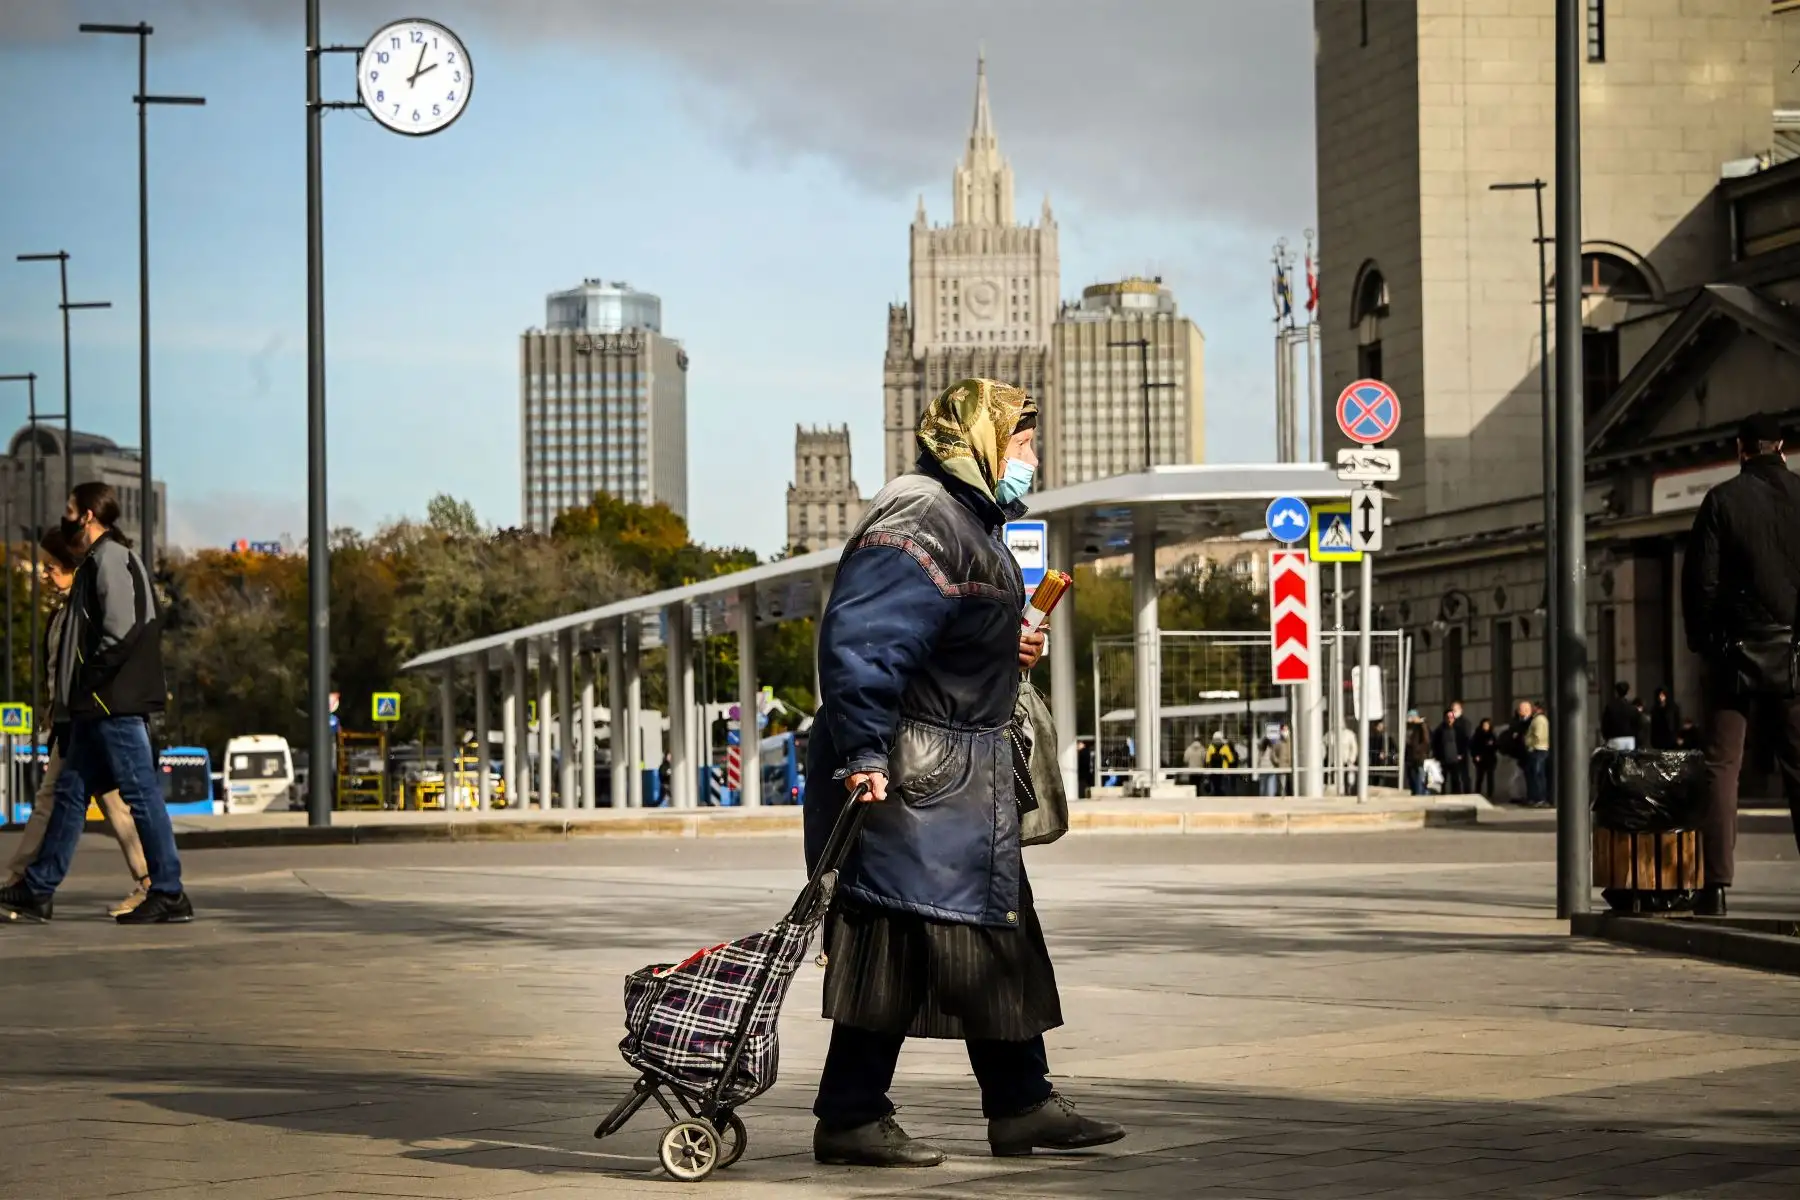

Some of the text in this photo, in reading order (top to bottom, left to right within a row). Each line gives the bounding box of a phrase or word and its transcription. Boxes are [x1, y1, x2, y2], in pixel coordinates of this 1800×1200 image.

[410, 31, 423, 43] 12
[391, 38, 400, 49] 11
[433, 38, 438, 49] 1
[376, 52, 389, 64] 10
[447, 52, 455, 64] 2
[370, 71, 378, 82] 9
[453, 71, 461, 82] 3
[377, 90, 384, 102] 8
[447, 91, 455, 101] 4
[394, 104, 400, 115] 7
[412, 109, 420, 121] 6
[432, 104, 440, 116] 5
